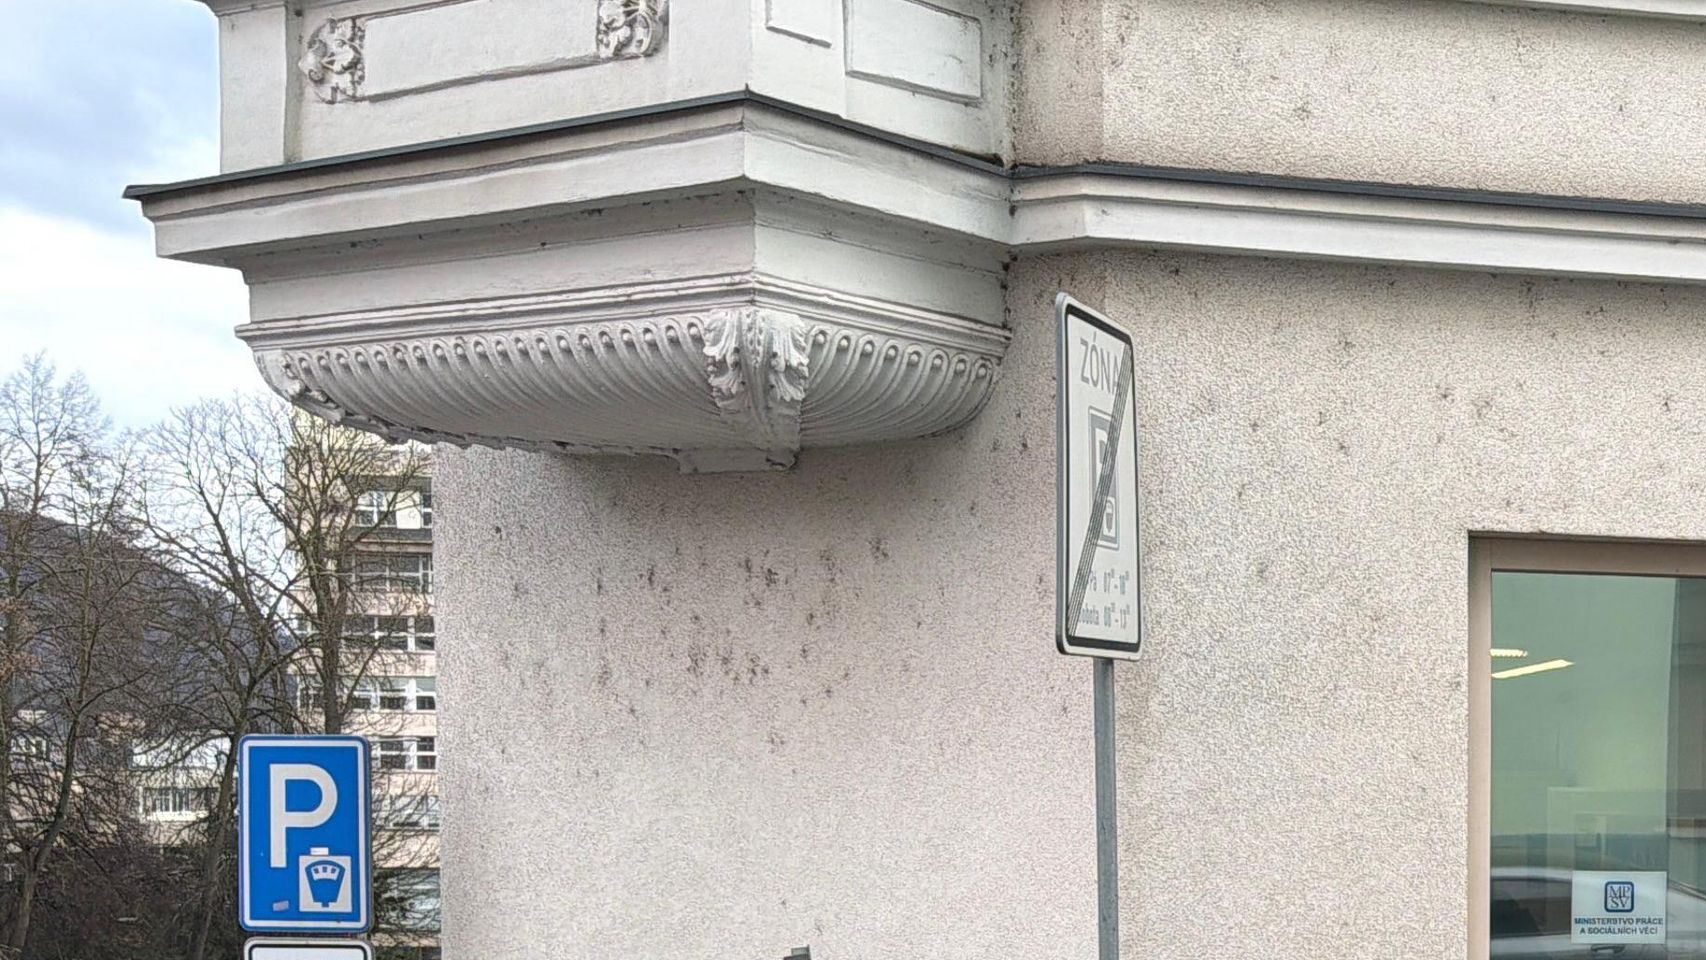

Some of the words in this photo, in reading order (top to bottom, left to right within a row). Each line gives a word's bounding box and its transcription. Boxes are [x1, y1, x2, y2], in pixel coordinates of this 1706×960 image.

[269, 763, 339, 869] P
[1574, 917, 1634, 925] MINISTERSTVO
[1635, 915, 1664, 925] PRÁCE
[1579, 927, 1586, 935] A
[1587, 925, 1637, 935] SOCIÁLNÍCH
